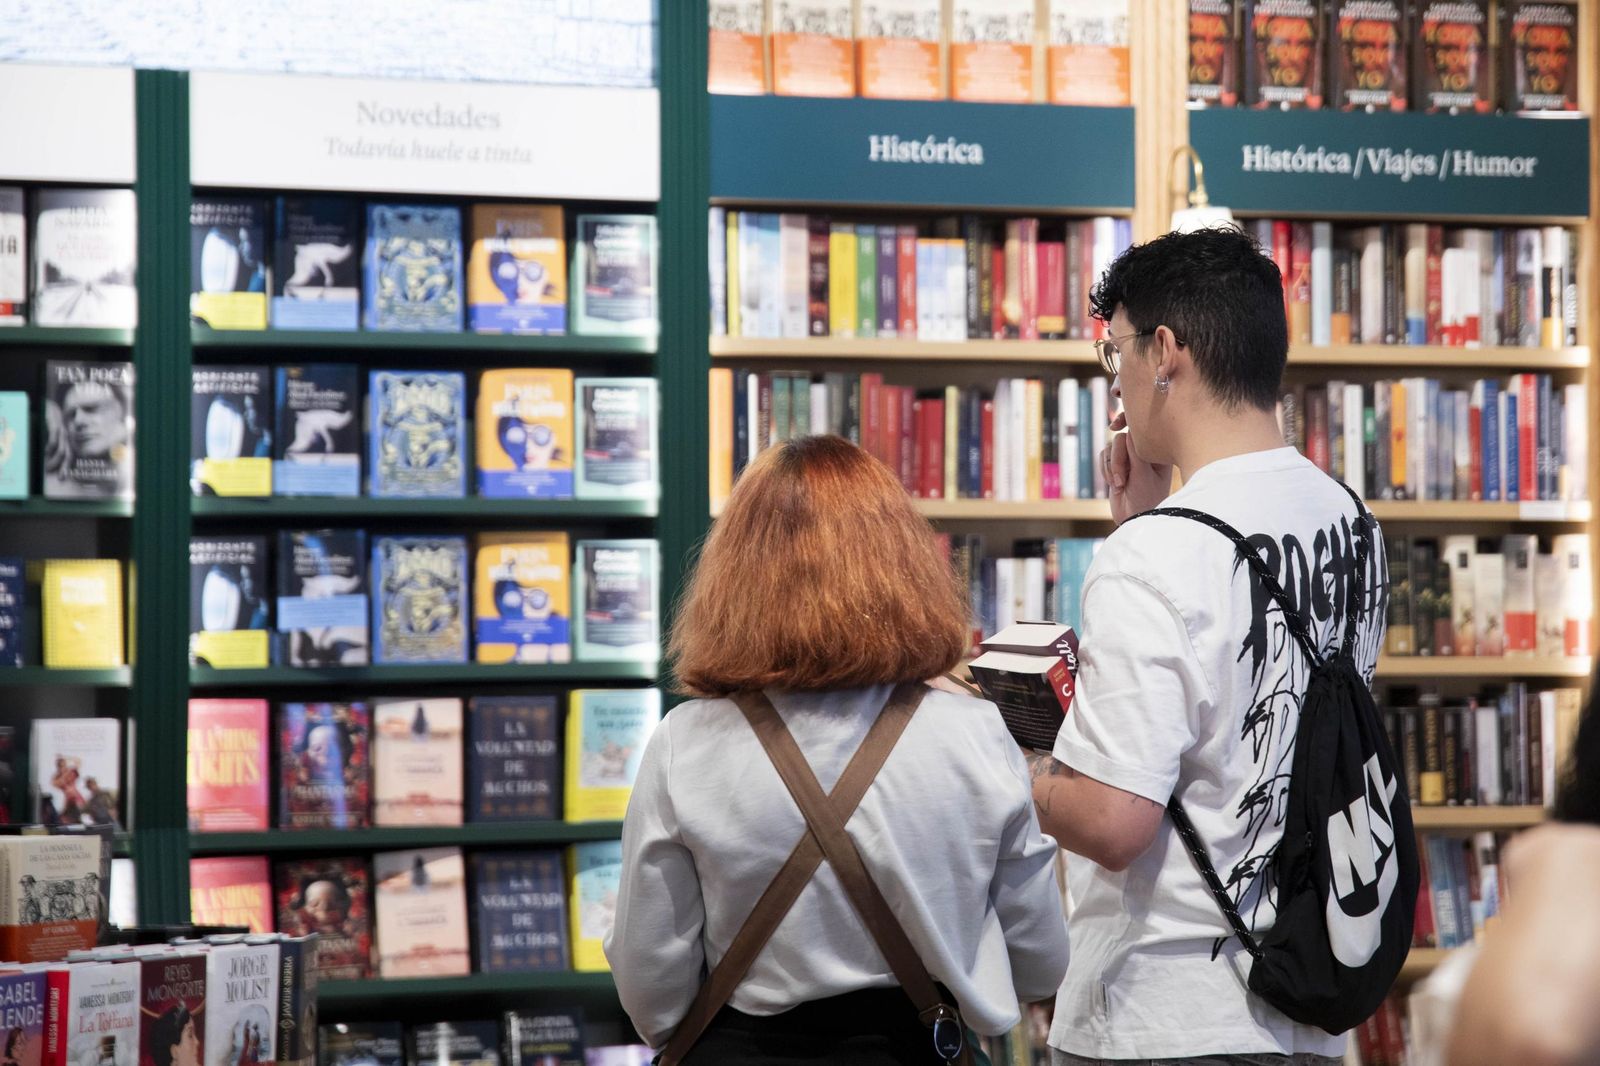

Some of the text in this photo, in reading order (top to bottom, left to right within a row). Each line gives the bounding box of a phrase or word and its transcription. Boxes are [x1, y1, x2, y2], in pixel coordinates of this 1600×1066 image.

[355, 100, 502, 129] Novedades
[324, 136, 533, 165] Todavía huele a tinta
[868, 134, 984, 165] Histórica
[55, 366, 87, 384] TAN
[164, 964, 192, 982] REYES
[228, 954, 269, 979] JORGE
[282, 955, 294, 985] SIERRA
[147, 979, 205, 1001] MONFORTE
[225, 977, 271, 1003] MOLIST
[282, 985, 293, 1017] JAVIER
[79, 1015, 95, 1034] La
